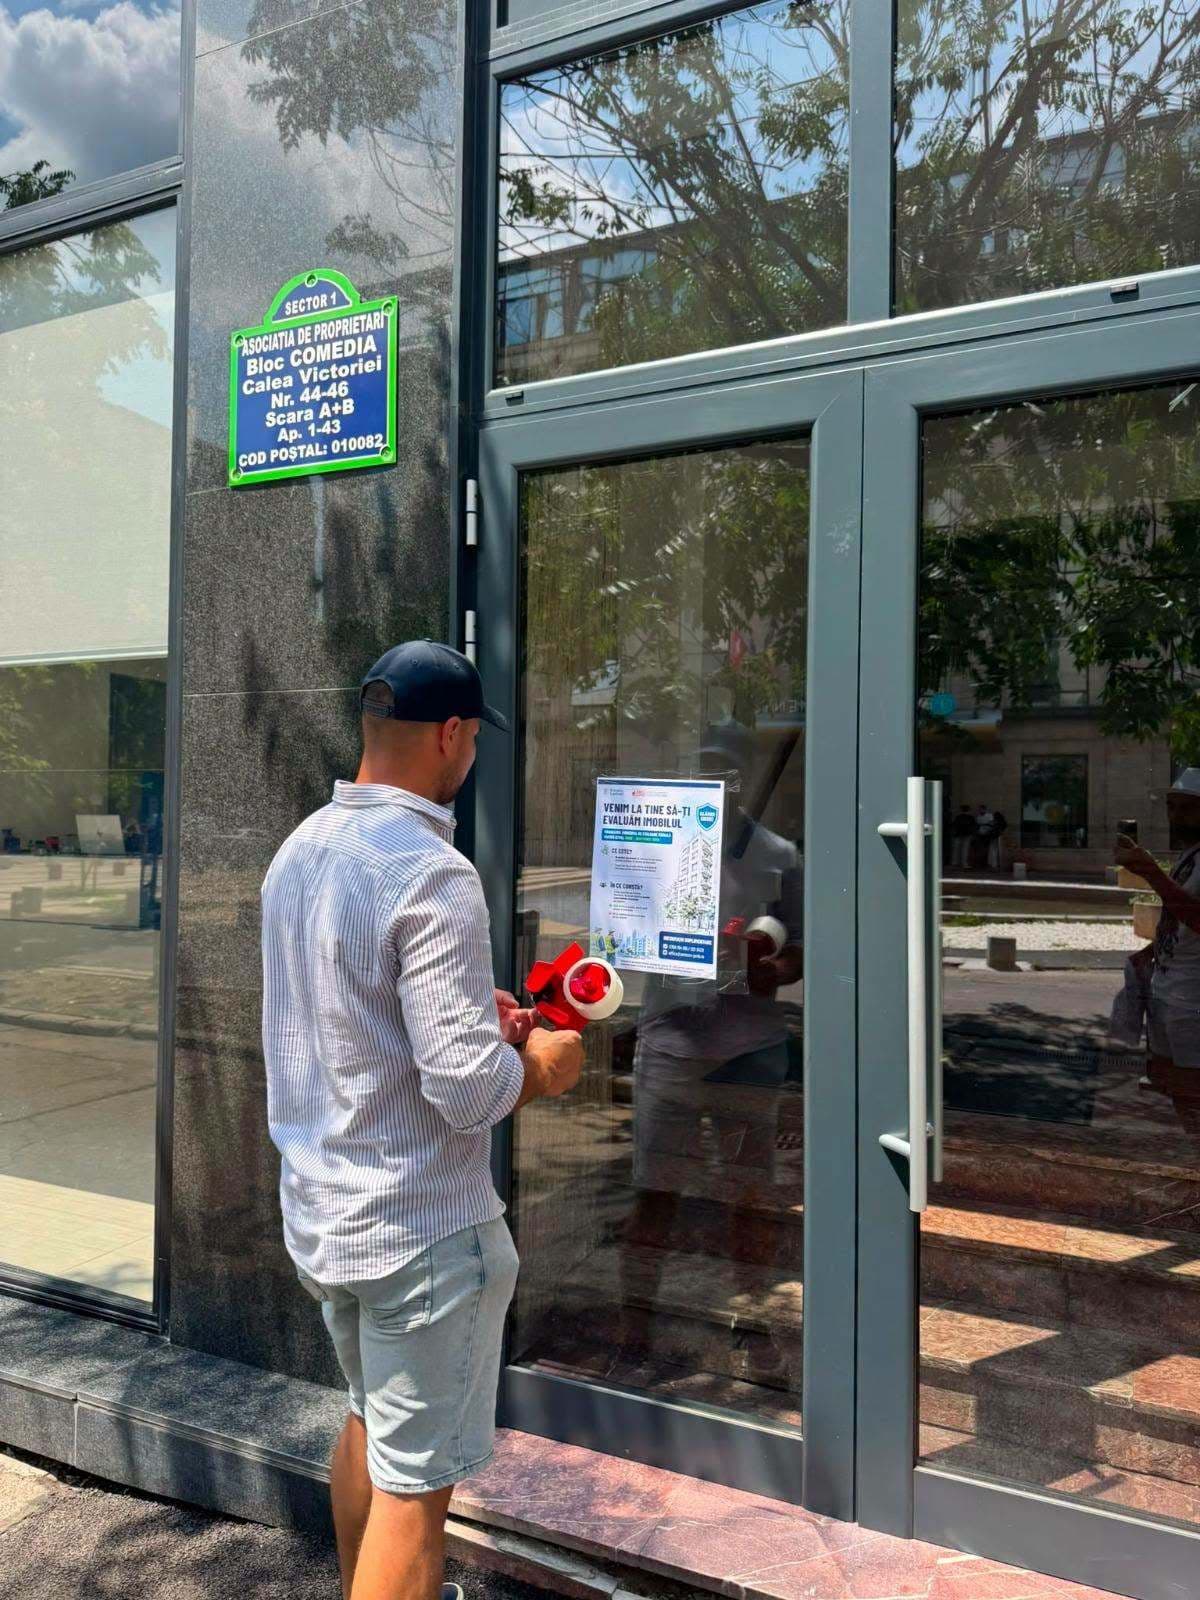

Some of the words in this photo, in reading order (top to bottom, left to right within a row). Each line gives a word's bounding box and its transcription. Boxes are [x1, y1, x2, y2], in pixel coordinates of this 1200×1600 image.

[285, 296, 328, 315] SECTOR
[331, 292, 337, 305] 1
[242, 329, 295, 356] ASOCIATIA
[298, 326, 312, 344] DE
[314, 312, 384, 342] PROPRIETARI
[247, 356, 285, 376] Bloc
[290, 335, 377, 367] COMEDIA
[242, 374, 294, 395] Calea
[299, 355, 382, 384] Victoriei
[271, 393, 295, 409] Nr.
[300, 381, 349, 403] 44-46
[265, 408, 314, 428] Scara
[319, 399, 355, 419] A+B
[277, 428, 302, 442] Ap.
[308, 419, 341, 437] 1-43
[239, 452, 266, 467] COD
[331, 434, 383, 453] 010082
[604, 803, 630, 813] VENIM
[631, 805, 642, 814] LA
[645, 805, 664, 815] TINE
[643, 817, 682, 829] IMOBILUL
